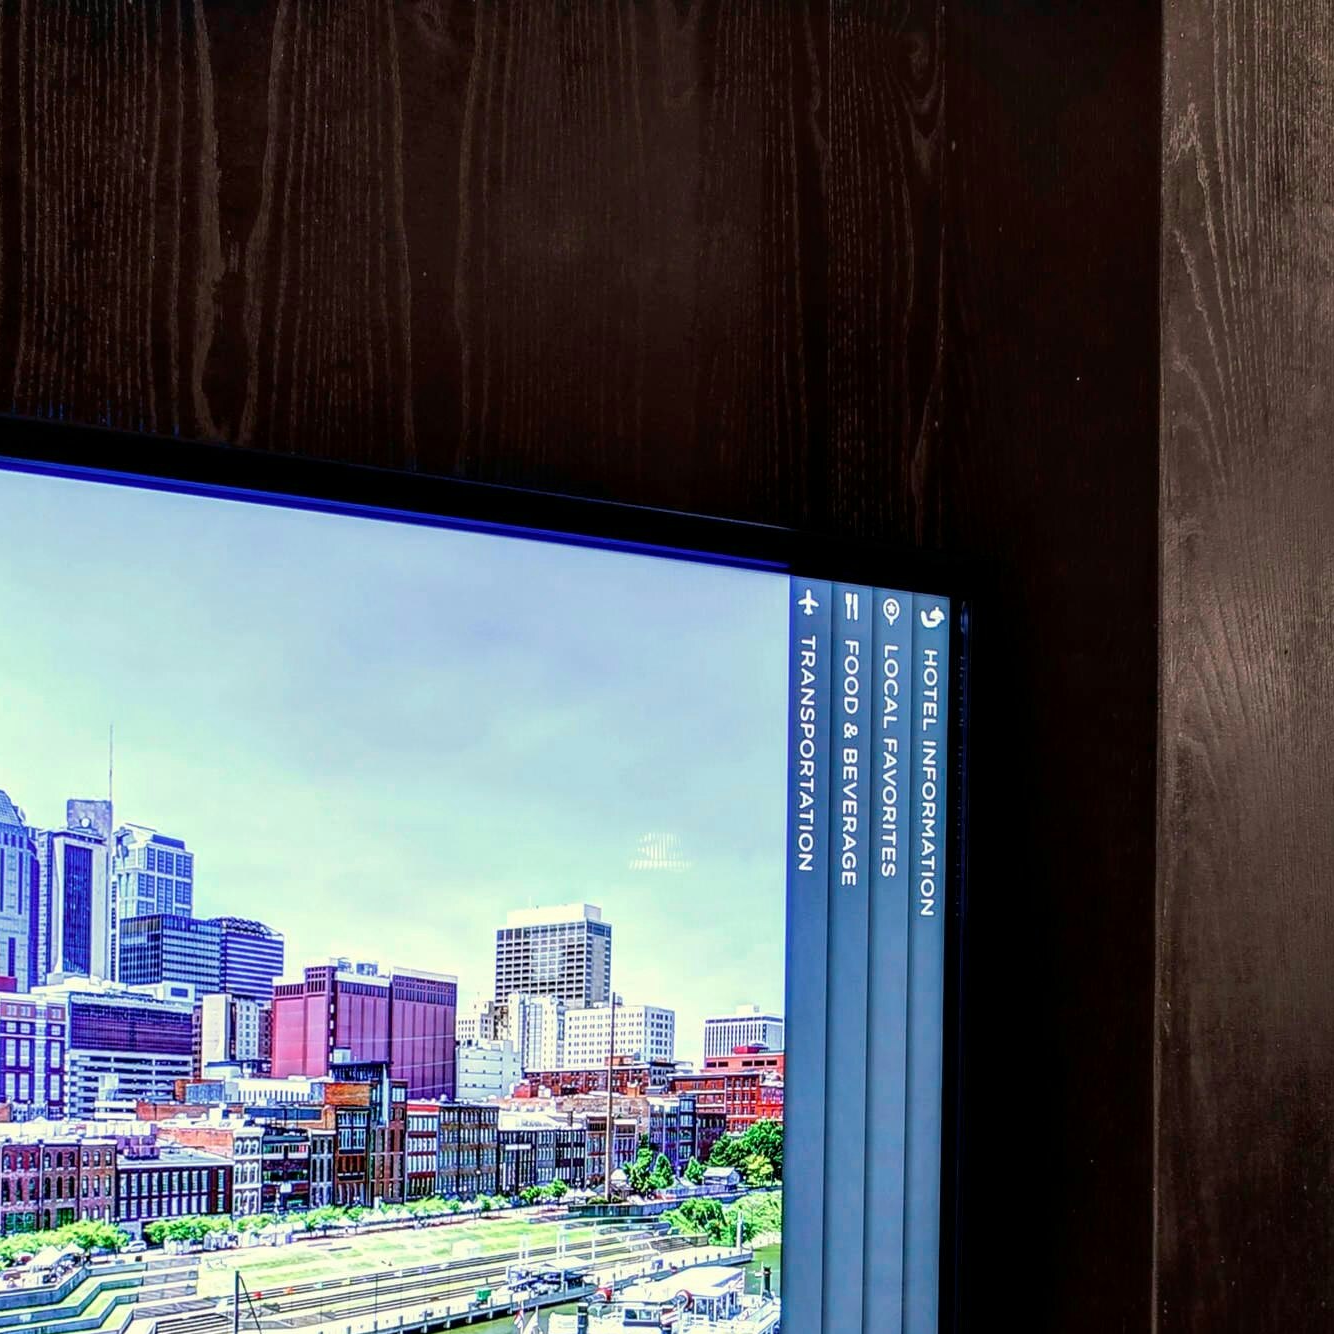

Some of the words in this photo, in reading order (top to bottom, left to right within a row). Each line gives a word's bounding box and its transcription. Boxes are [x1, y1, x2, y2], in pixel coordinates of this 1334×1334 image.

[843, 639, 859, 715] FOOD
[843, 722, 858, 739] &
[883, 644, 899, 729] LOCAL
[922, 649, 938, 731] HOTEL
[798, 635, 816, 872] TRANSPORTATION
[881, 738, 898, 878] FAVORITES
[841, 748, 858, 887] BEVERAGE
[920, 740, 937, 917] INFORMATION
